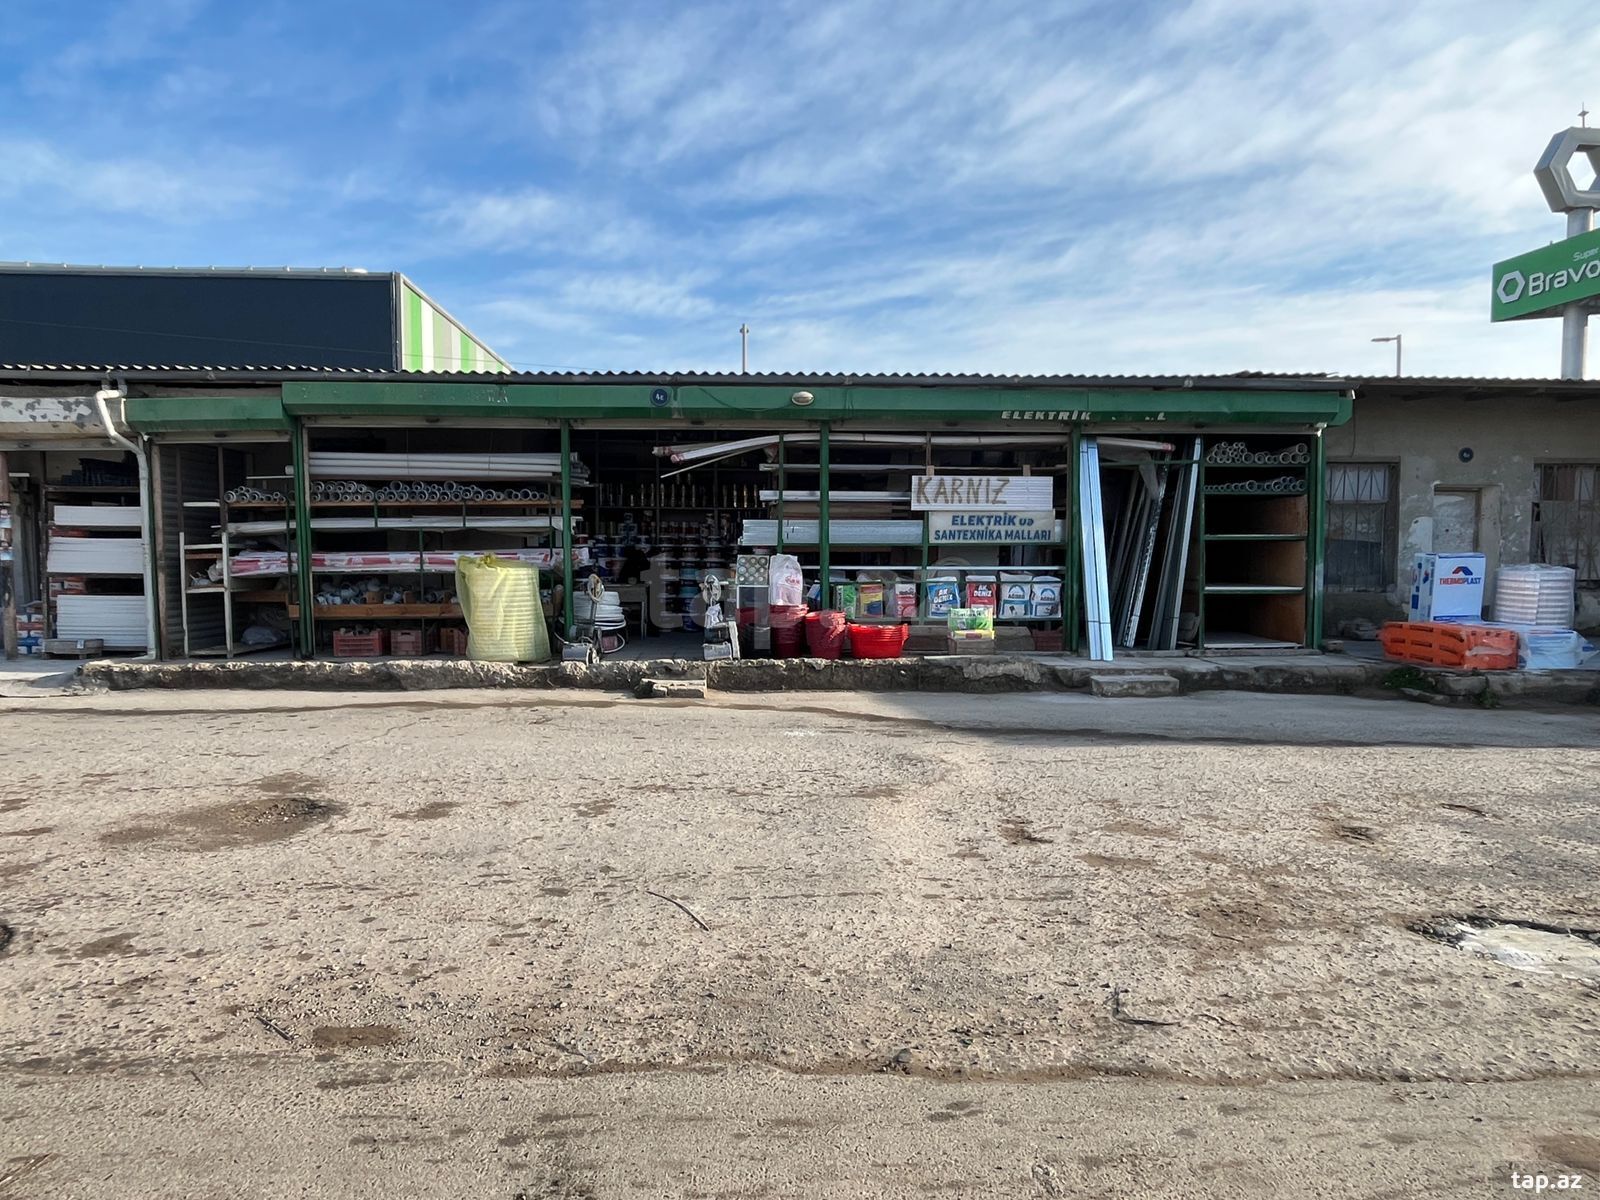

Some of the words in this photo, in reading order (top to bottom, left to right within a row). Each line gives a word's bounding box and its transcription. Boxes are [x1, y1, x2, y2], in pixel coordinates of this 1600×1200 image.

[1573, 247, 1599, 261] Super
[1528, 260, 1600, 297] Bravo
[916, 476, 1010, 505] KARNIZ
[951, 513, 1017, 527] ELEKTRİK
[934, 527, 1002, 541] SANTEXNİKA
[1005, 529, 1051, 541] MALLARI
